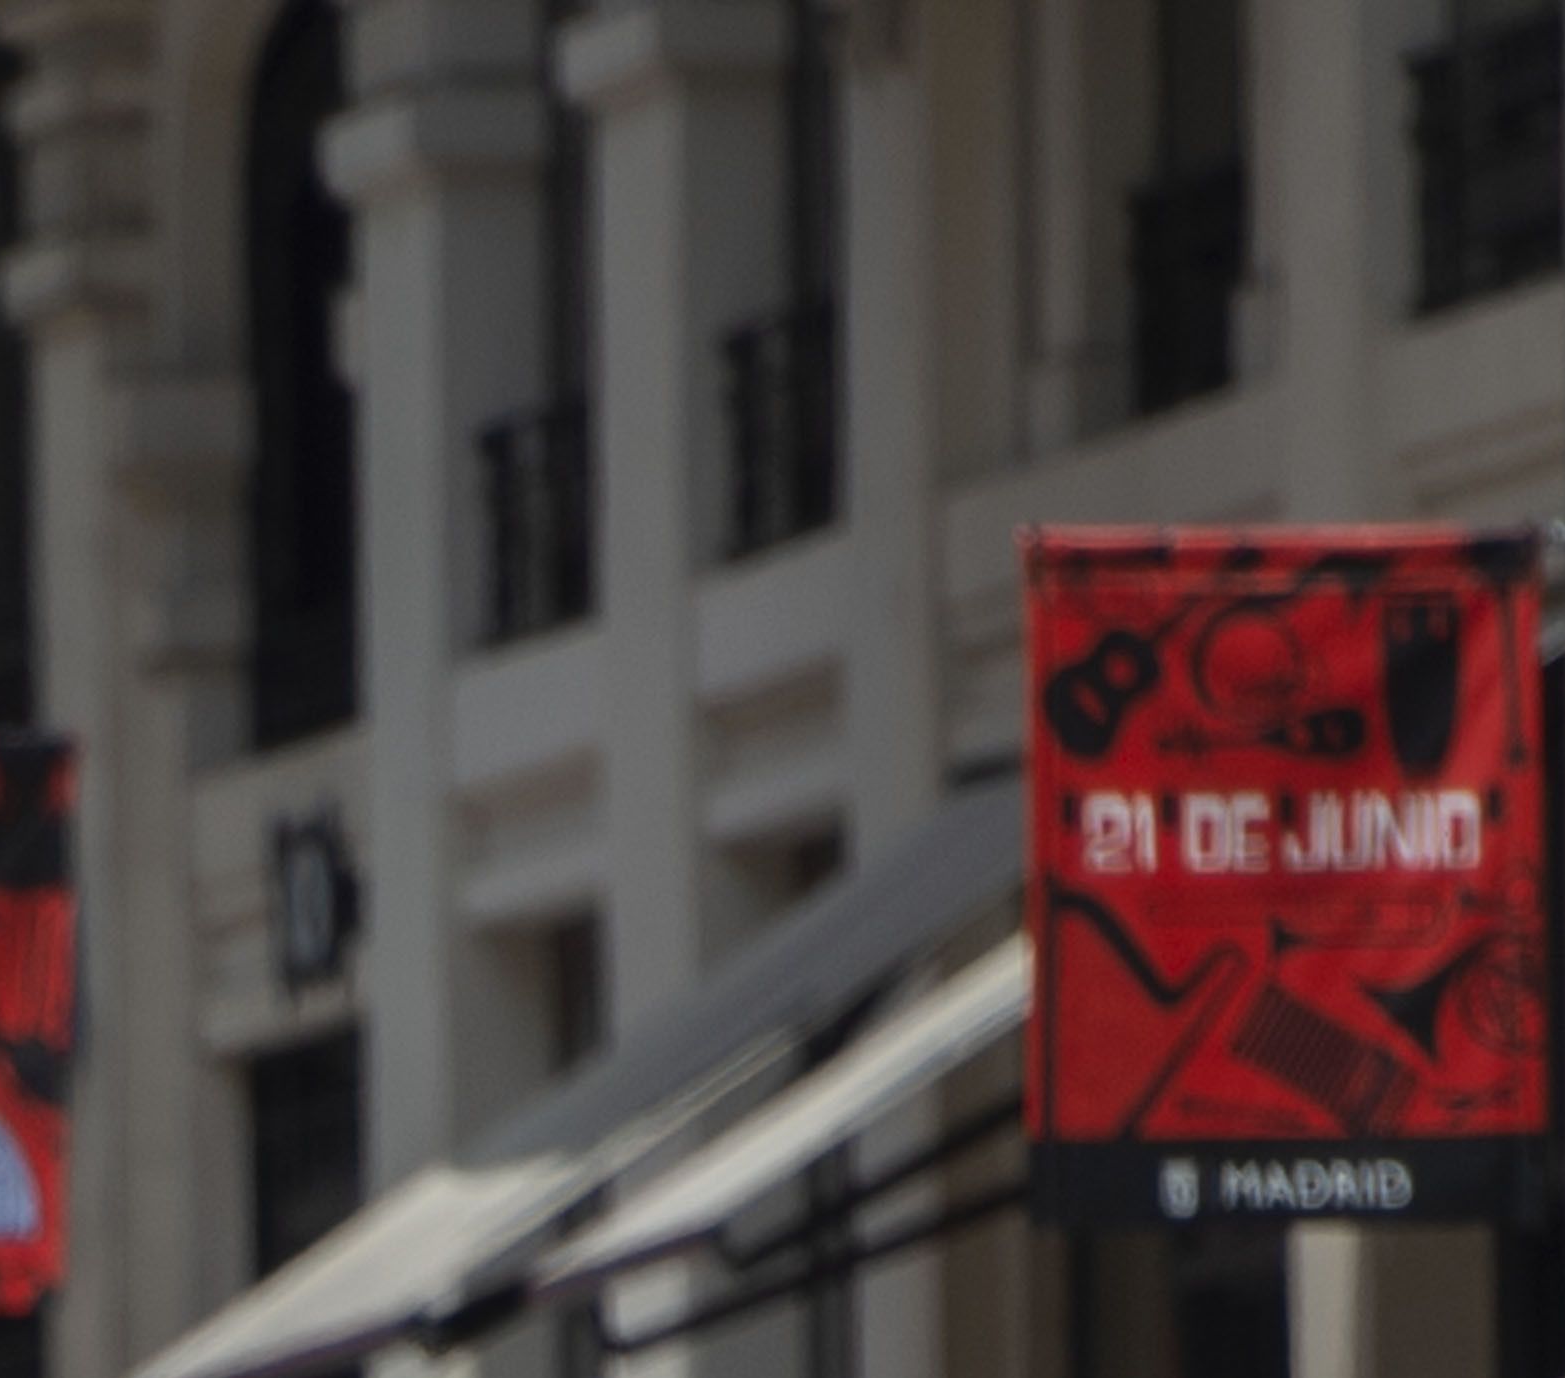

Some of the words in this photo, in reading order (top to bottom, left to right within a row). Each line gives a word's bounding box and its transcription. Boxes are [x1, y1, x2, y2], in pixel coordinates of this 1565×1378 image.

[1082, 791, 1157, 873] 21
[1181, 791, 1270, 873] DE
[1282, 788, 1482, 872] JUNIO
[1220, 1157, 1414, 1212] MADRID
